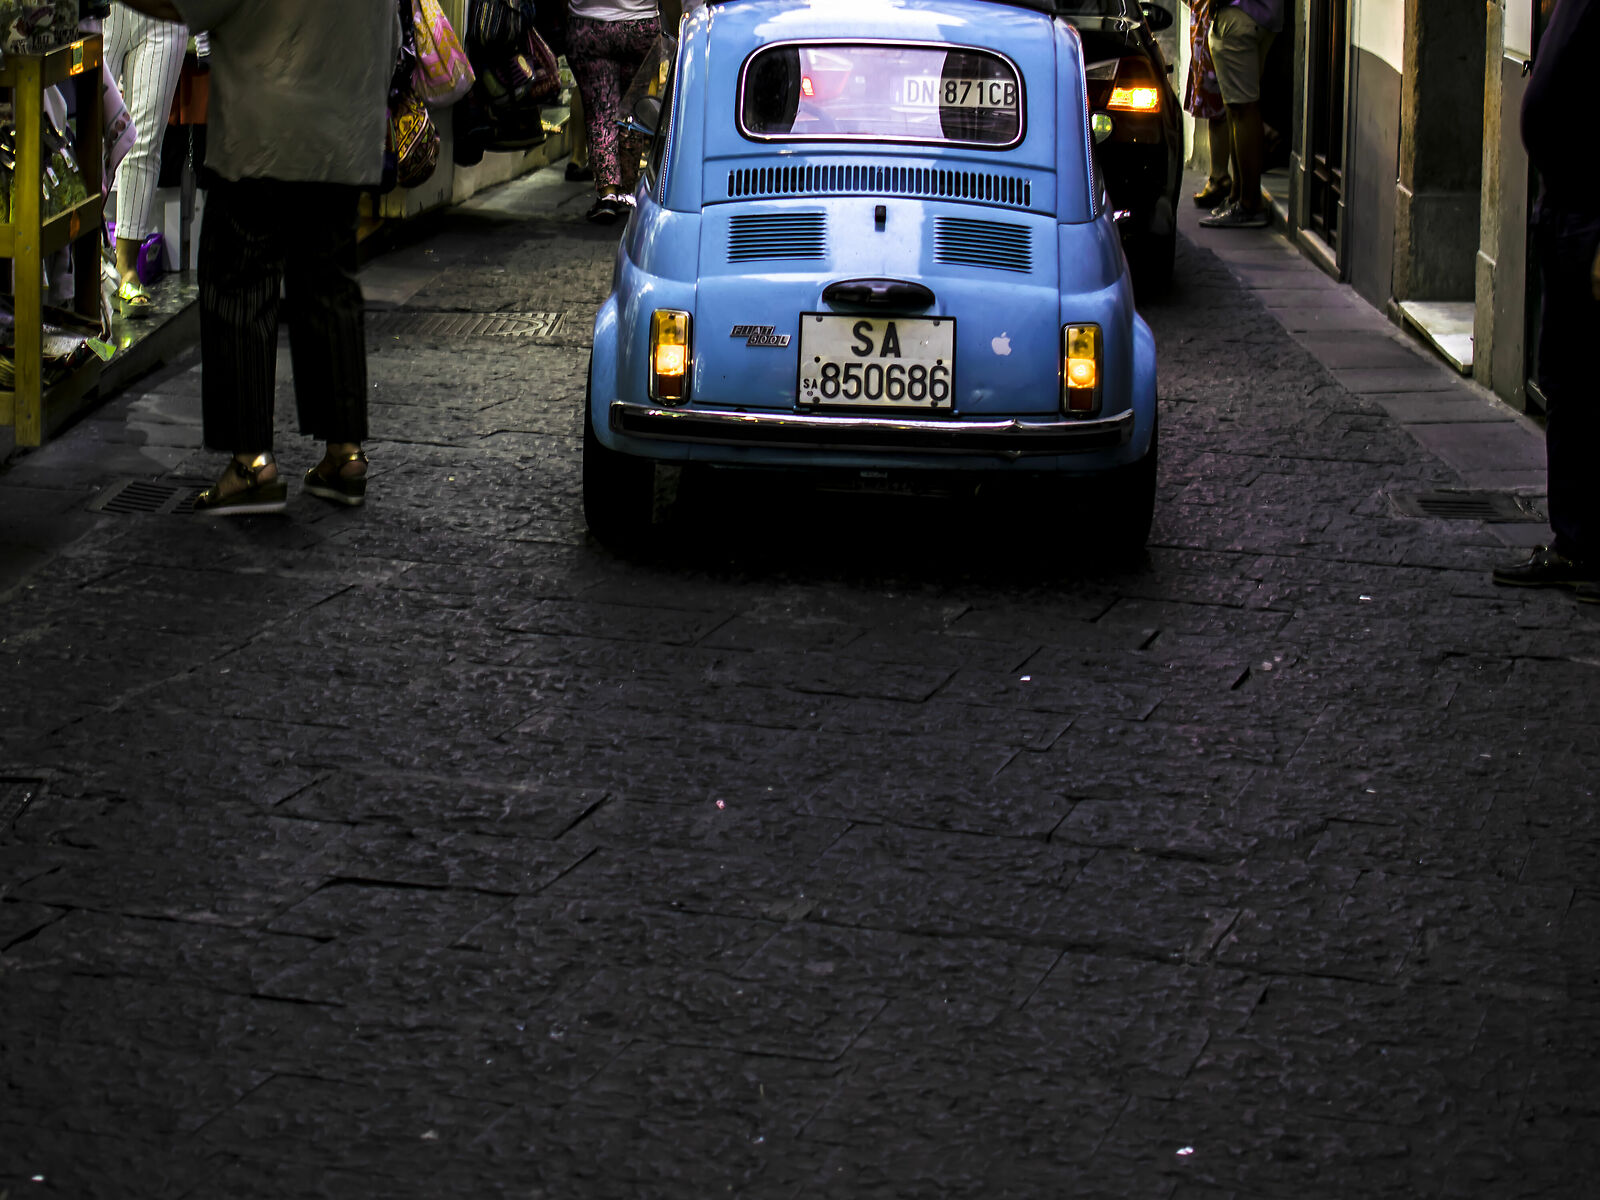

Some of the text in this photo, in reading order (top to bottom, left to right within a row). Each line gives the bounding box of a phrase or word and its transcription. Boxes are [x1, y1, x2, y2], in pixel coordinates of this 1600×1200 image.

[733, 326, 773, 335] FIAT
[749, 335, 788, 346] 500L
[850, 320, 902, 358] SA
[820, 362, 949, 402] 850686
